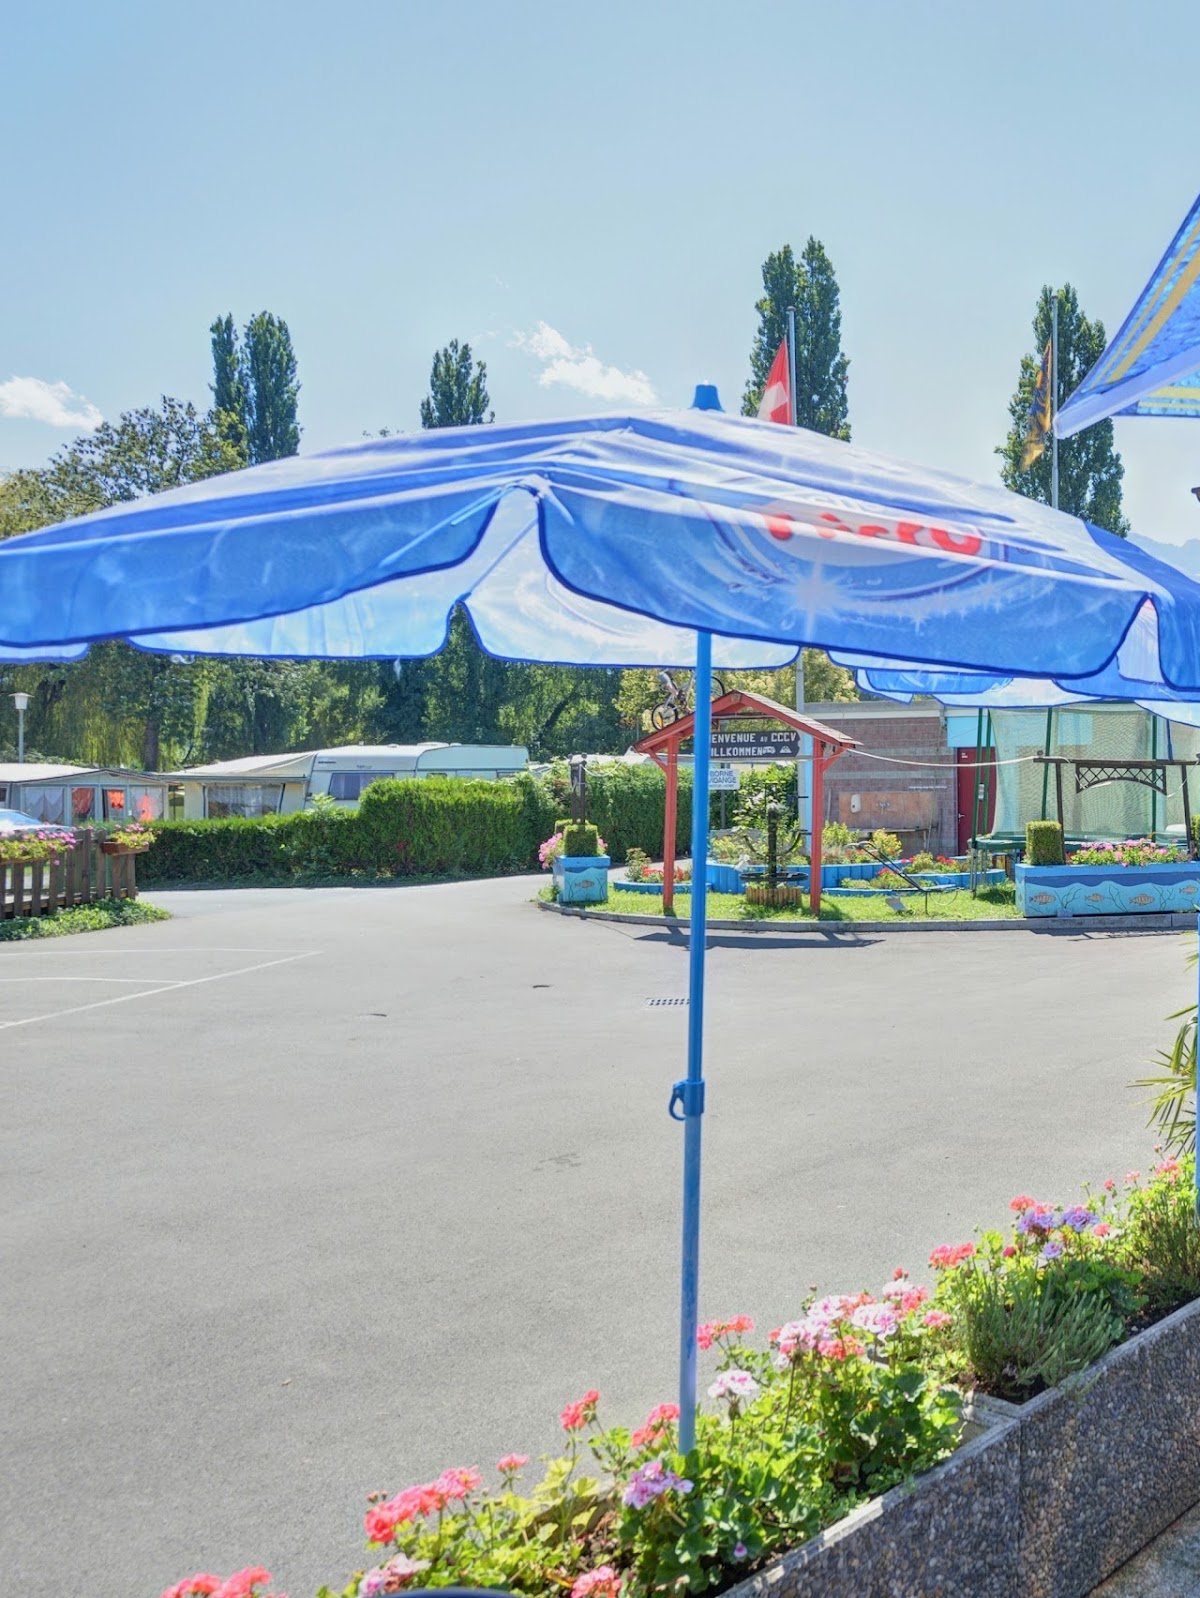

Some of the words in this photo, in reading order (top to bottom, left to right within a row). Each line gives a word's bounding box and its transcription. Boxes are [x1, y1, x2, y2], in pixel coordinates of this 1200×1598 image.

[711, 732, 756, 744] ENVENUE
[771, 732, 797, 742] CCCV
[711, 746, 763, 757] ILLKOMMEN
